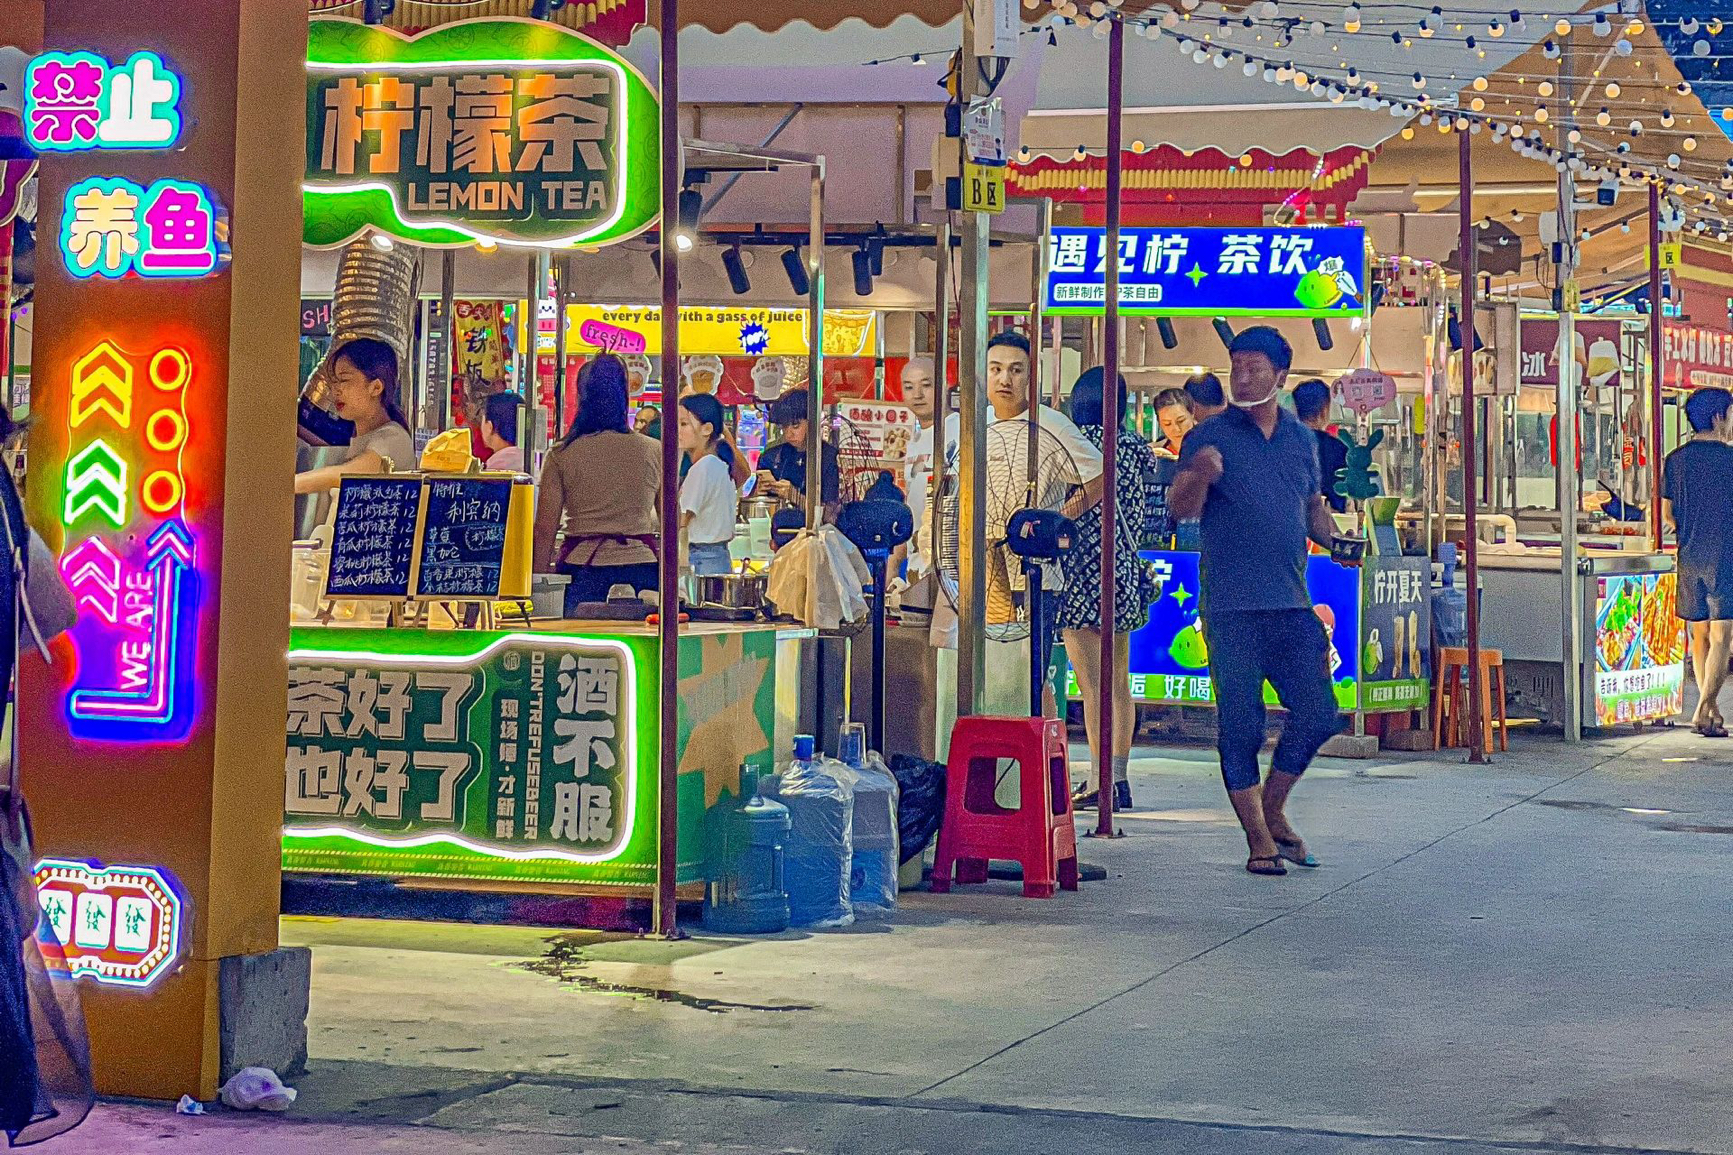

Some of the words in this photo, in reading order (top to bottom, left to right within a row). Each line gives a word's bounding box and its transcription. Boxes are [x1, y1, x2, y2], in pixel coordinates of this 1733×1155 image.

[31, 59, 173, 142] 禁止
[320, 73, 610, 174] 柠檬茶
[408, 181, 523, 211] LEMON
[541, 180, 607, 210] TEA
[68, 187, 214, 270] 养鱼
[1049, 234, 1189, 276] 遇见柠
[1217, 234, 1315, 276] 茶饮
[1056, 286, 1105, 299] 新鲜制作
[602, 312, 641, 323] every
[644, 311, 661, 321] da
[678, 311, 702, 322] ith
[706, 313, 713, 321] a
[717, 312, 747, 323] gass
[750, 311, 765, 321] of
[767, 311, 803, 323] juice
[1522, 352, 1546, 377] 冰
[405, 490, 418, 500] 12
[400, 522, 414, 533] 12
[404, 506, 416, 518] 12
[397, 553, 409, 563] 12
[398, 538, 412, 549] 12
[396, 571, 408, 585] 12
[1374, 570, 1423, 603] 柠开夏天
[123, 570, 154, 630] ARE
[121, 638, 151, 690] WE
[287, 666, 475, 743] 茶好了
[550, 653, 618, 843] 酒不服
[285, 745, 471, 822] 也好了
